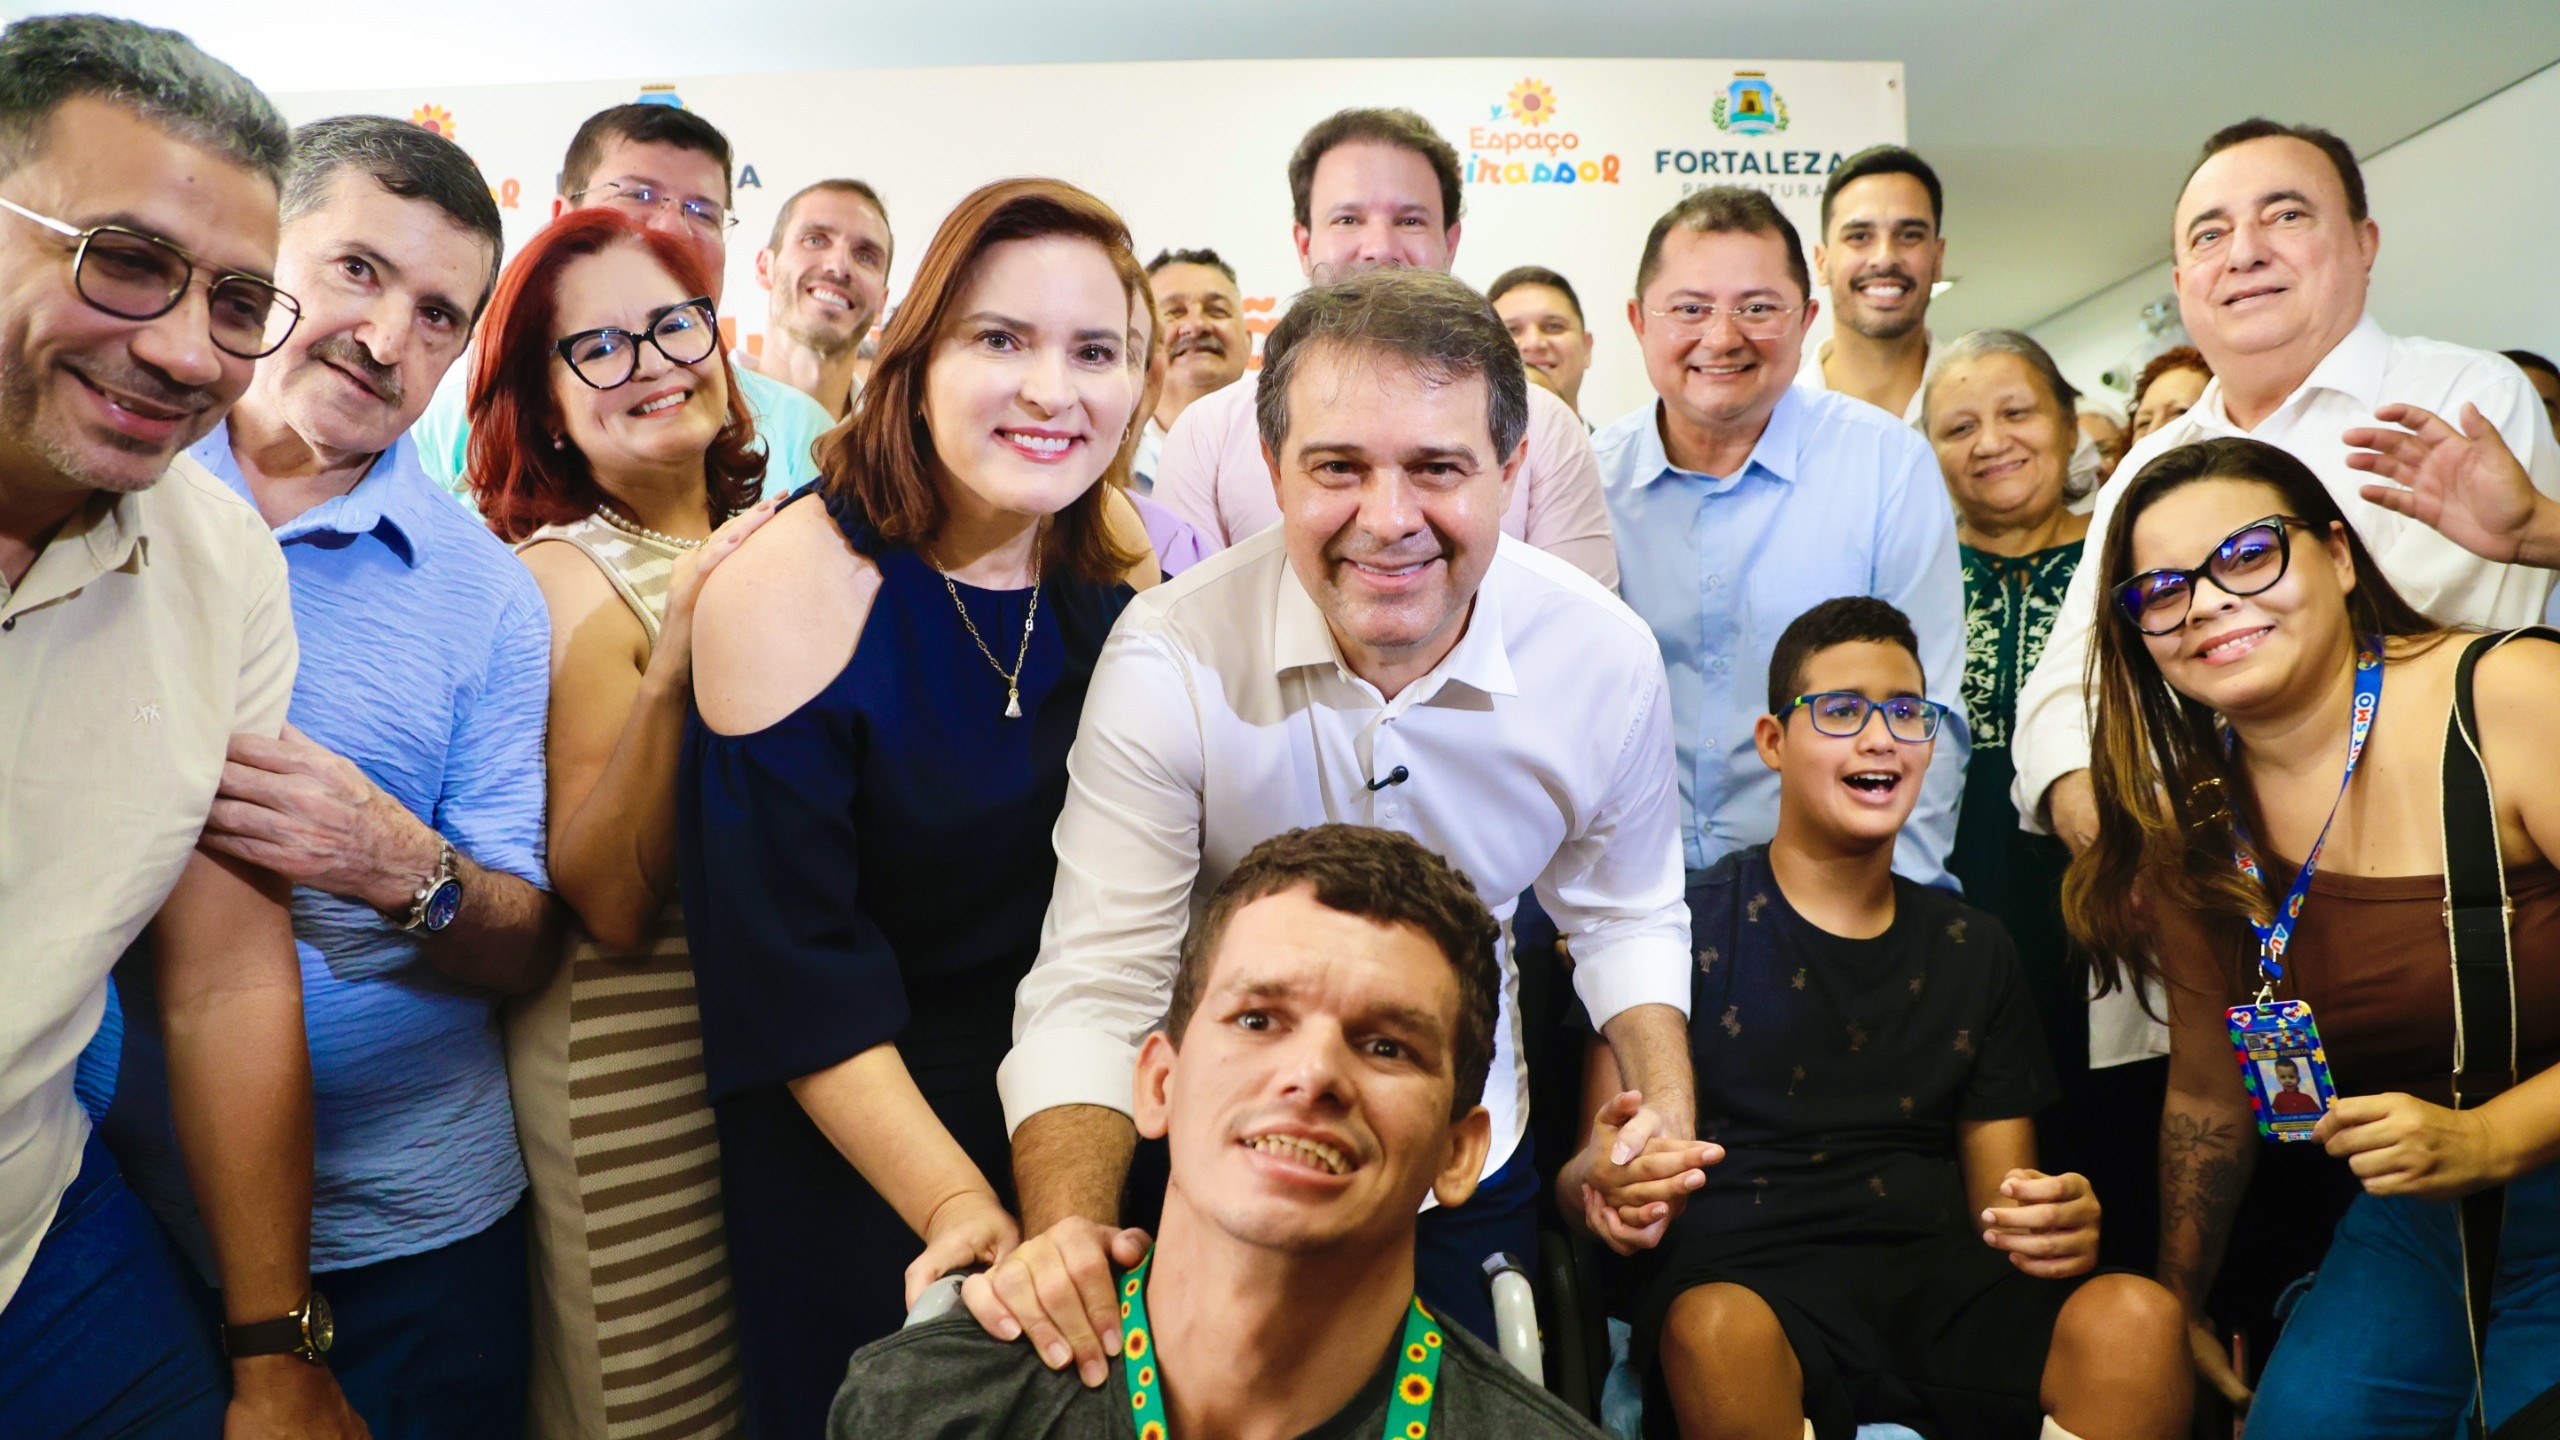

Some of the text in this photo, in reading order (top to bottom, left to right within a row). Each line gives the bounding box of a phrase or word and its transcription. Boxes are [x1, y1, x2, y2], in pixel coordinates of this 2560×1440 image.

[1469, 127, 1579, 157] Espaço
[1463, 152, 1620, 185] irassol
[1655, 150, 1845, 174] FORTALEZA
[1682, 182, 1826, 198] PRITURA
